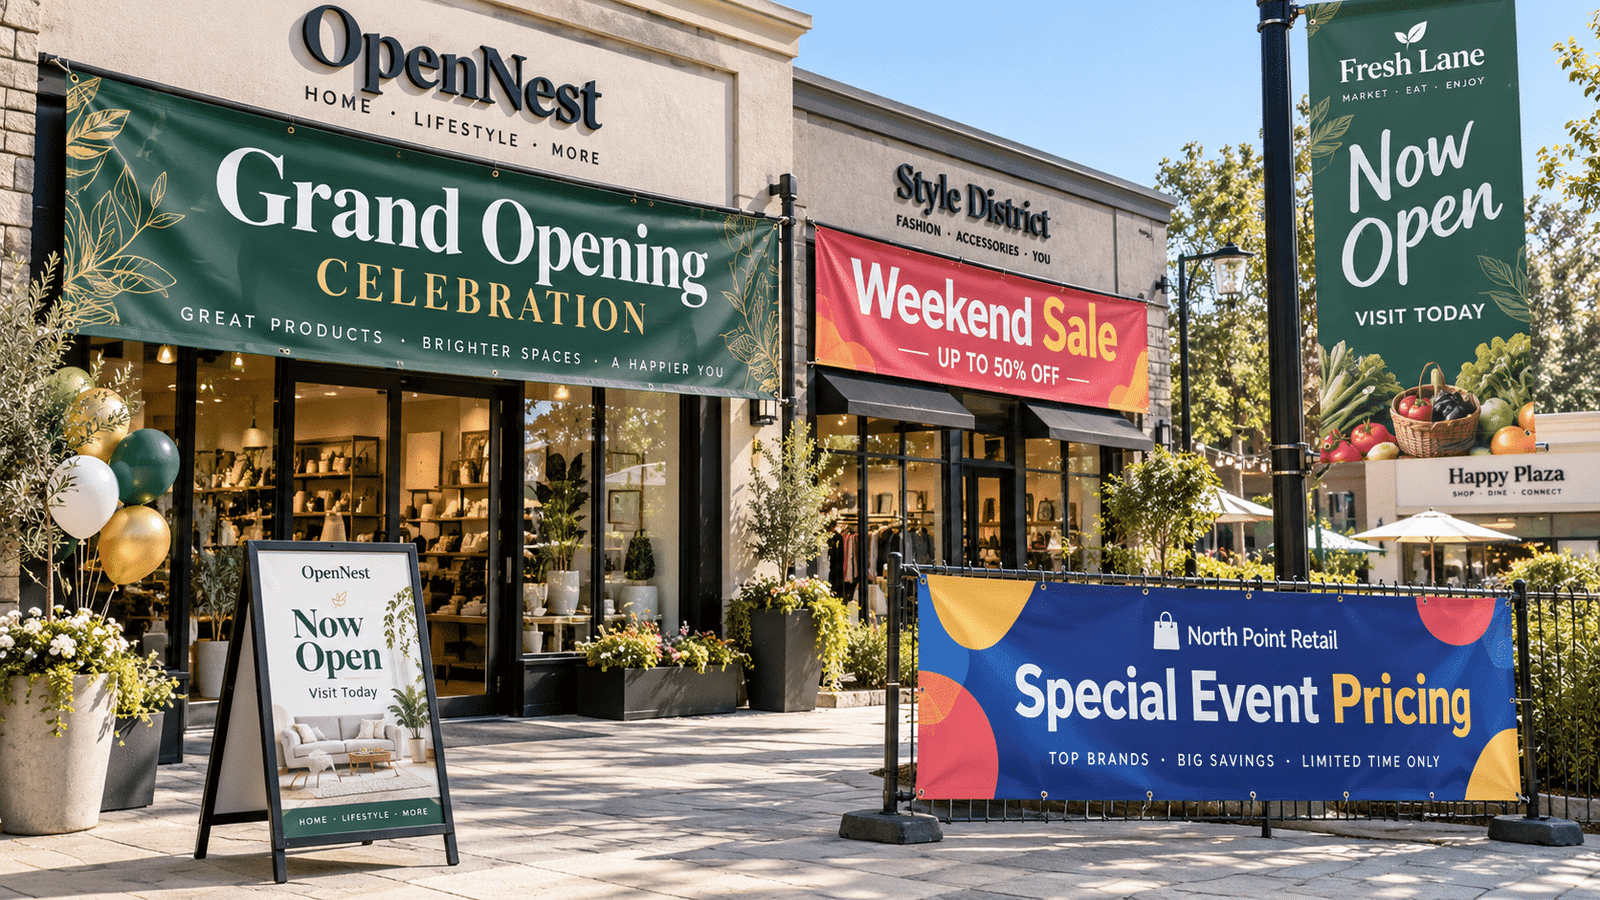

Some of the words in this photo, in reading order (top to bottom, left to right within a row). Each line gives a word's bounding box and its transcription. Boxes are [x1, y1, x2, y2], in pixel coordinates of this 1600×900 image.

[302, 4, 602, 130] OpenNest
[1340, 52, 1412, 83] Fresh
[1419, 49, 1484, 72] Lane
[1342, 89, 1388, 102] MARKET
[1406, 84, 1427, 94] EAT
[1446, 76, 1485, 89] ENJOY
[305, 85, 371, 114] HOME
[414, 111, 518, 147] LIFESTYLE
[552, 143, 599, 165] MORE
[1349, 120, 1474, 213] Now
[896, 163, 961, 215] Style
[967, 184, 1051, 239] District
[216, 147, 462, 254] Grand
[482, 198, 708, 307] Opening
[896, 214, 941, 236] FASHION
[956, 231, 1019, 256] ACCESSORIES
[1032, 250, 1050, 264] YOU
[1342, 182, 1503, 287] Open
[317, 258, 646, 335] CELEBRATION
[851, 257, 1032, 346] Weekend
[1043, 296, 1117, 361] Sale
[1355, 309, 1406, 326] VISIT
[1414, 303, 1484, 322] TODAY
[181, 307, 255, 328] GREAT
[272, 318, 381, 343] PRODUCTS
[423, 337, 509, 357] BRIGHTER
[522, 347, 580, 364] SPACES
[611, 356, 621, 369] A
[630, 359, 688, 374] HAPPIER
[698, 365, 723, 377] YOU
[939, 347, 960, 368] UP
[966, 351, 988, 374] TO
[994, 357, 1026, 380] 50%
[1032, 364, 1059, 385] OFF
[1449, 468, 1508, 488] Happy
[1514, 465, 1565, 482] Plaza
[1452, 490, 1475, 498] SHOP
[1521, 488, 1562, 496] CONNECT
[301, 564, 370, 583] OpenNest
[292, 609, 363, 638] Now
[1189, 626, 1237, 646] North
[1243, 628, 1286, 647] Point
[1292, 629, 1337, 649] Retail
[296, 642, 382, 679] Open
[309, 688, 337, 698] Visit
[341, 686, 377, 700] Today
[1015, 664, 1176, 731] Special
[1192, 670, 1319, 723] Event
[1333, 673, 1471, 737] Pricing
[1049, 752, 1078, 764] TOP
[1088, 752, 1148, 765] BRANDS
[1178, 754, 1202, 766] BIG
[1211, 754, 1274, 767] SAVINGS
[1303, 755, 1360, 767] LIMITED
[1368, 755, 1400, 767] TIME
[1407, 756, 1439, 767] ONLY
[300, 816, 326, 825] HOME
[342, 811, 389, 821] LIFESTYLE
[403, 808, 428, 816] MORE
